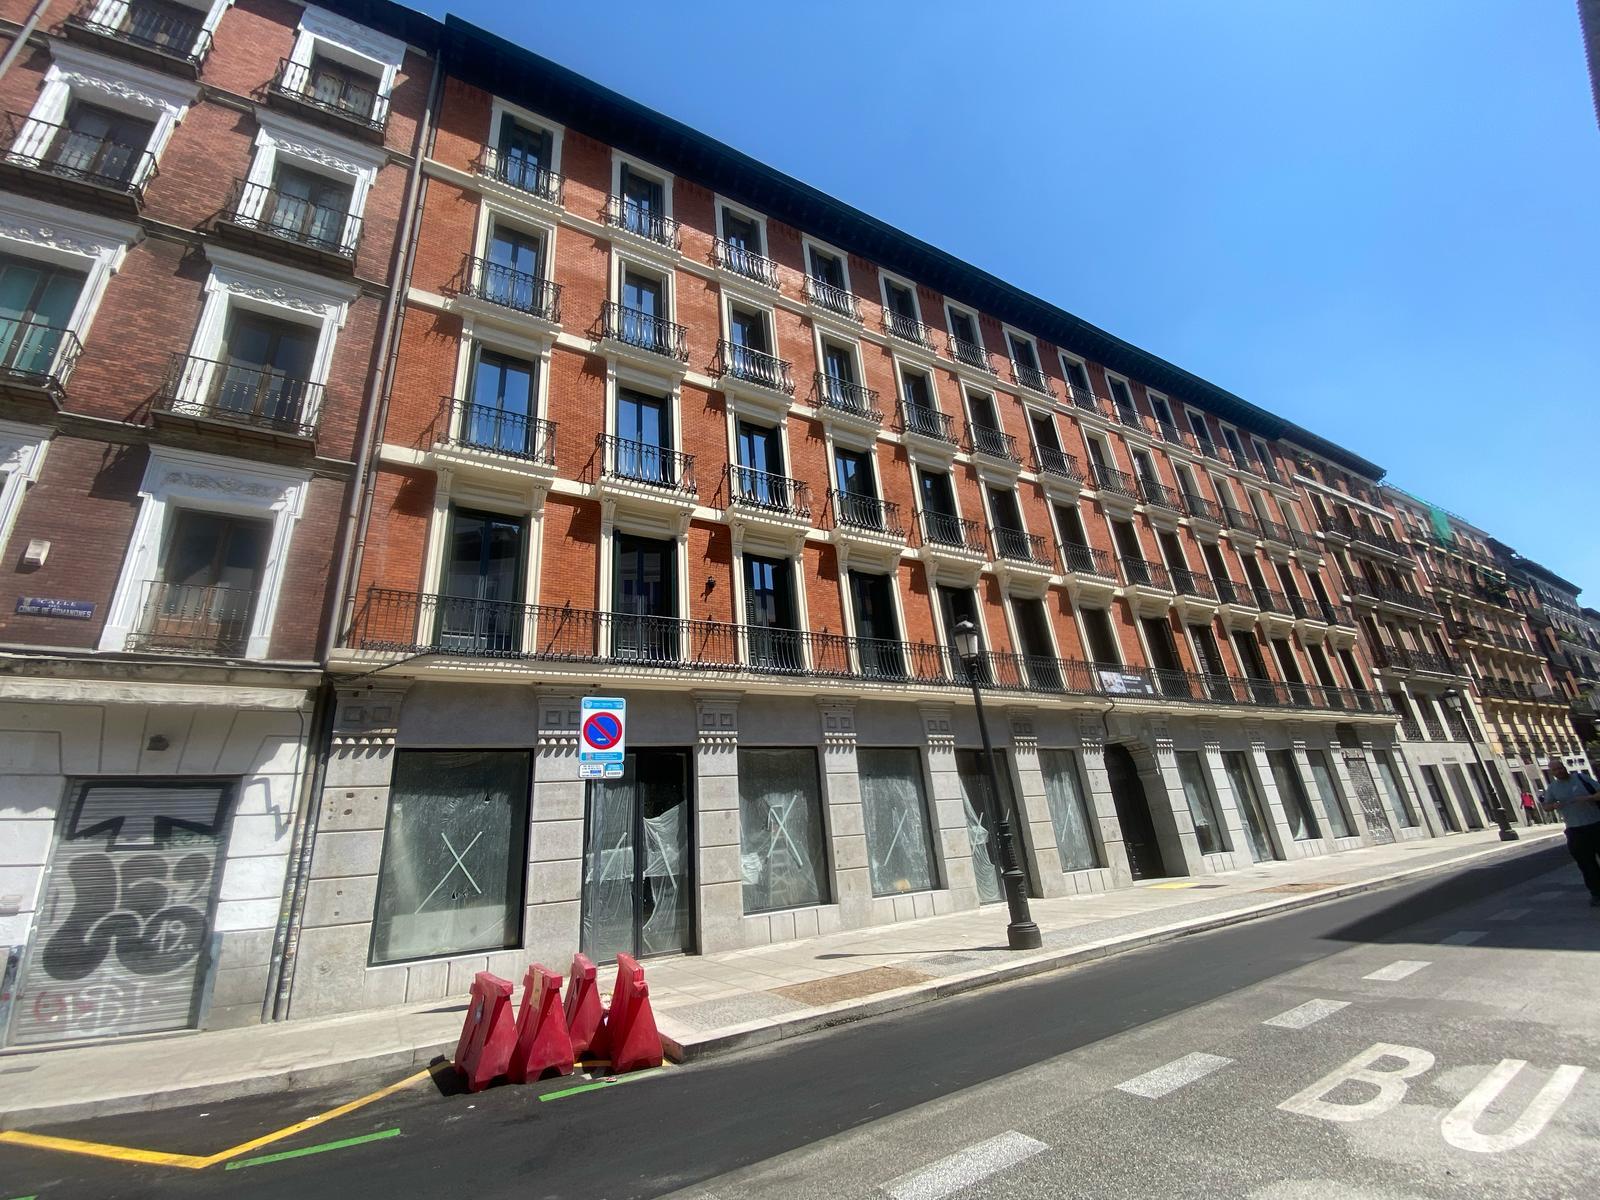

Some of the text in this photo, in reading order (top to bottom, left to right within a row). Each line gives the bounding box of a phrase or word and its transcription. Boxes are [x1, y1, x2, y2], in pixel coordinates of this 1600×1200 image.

[40, 599, 77, 607] CALLE
[18, 605, 92, 618] CONDE DE ROMANONES
